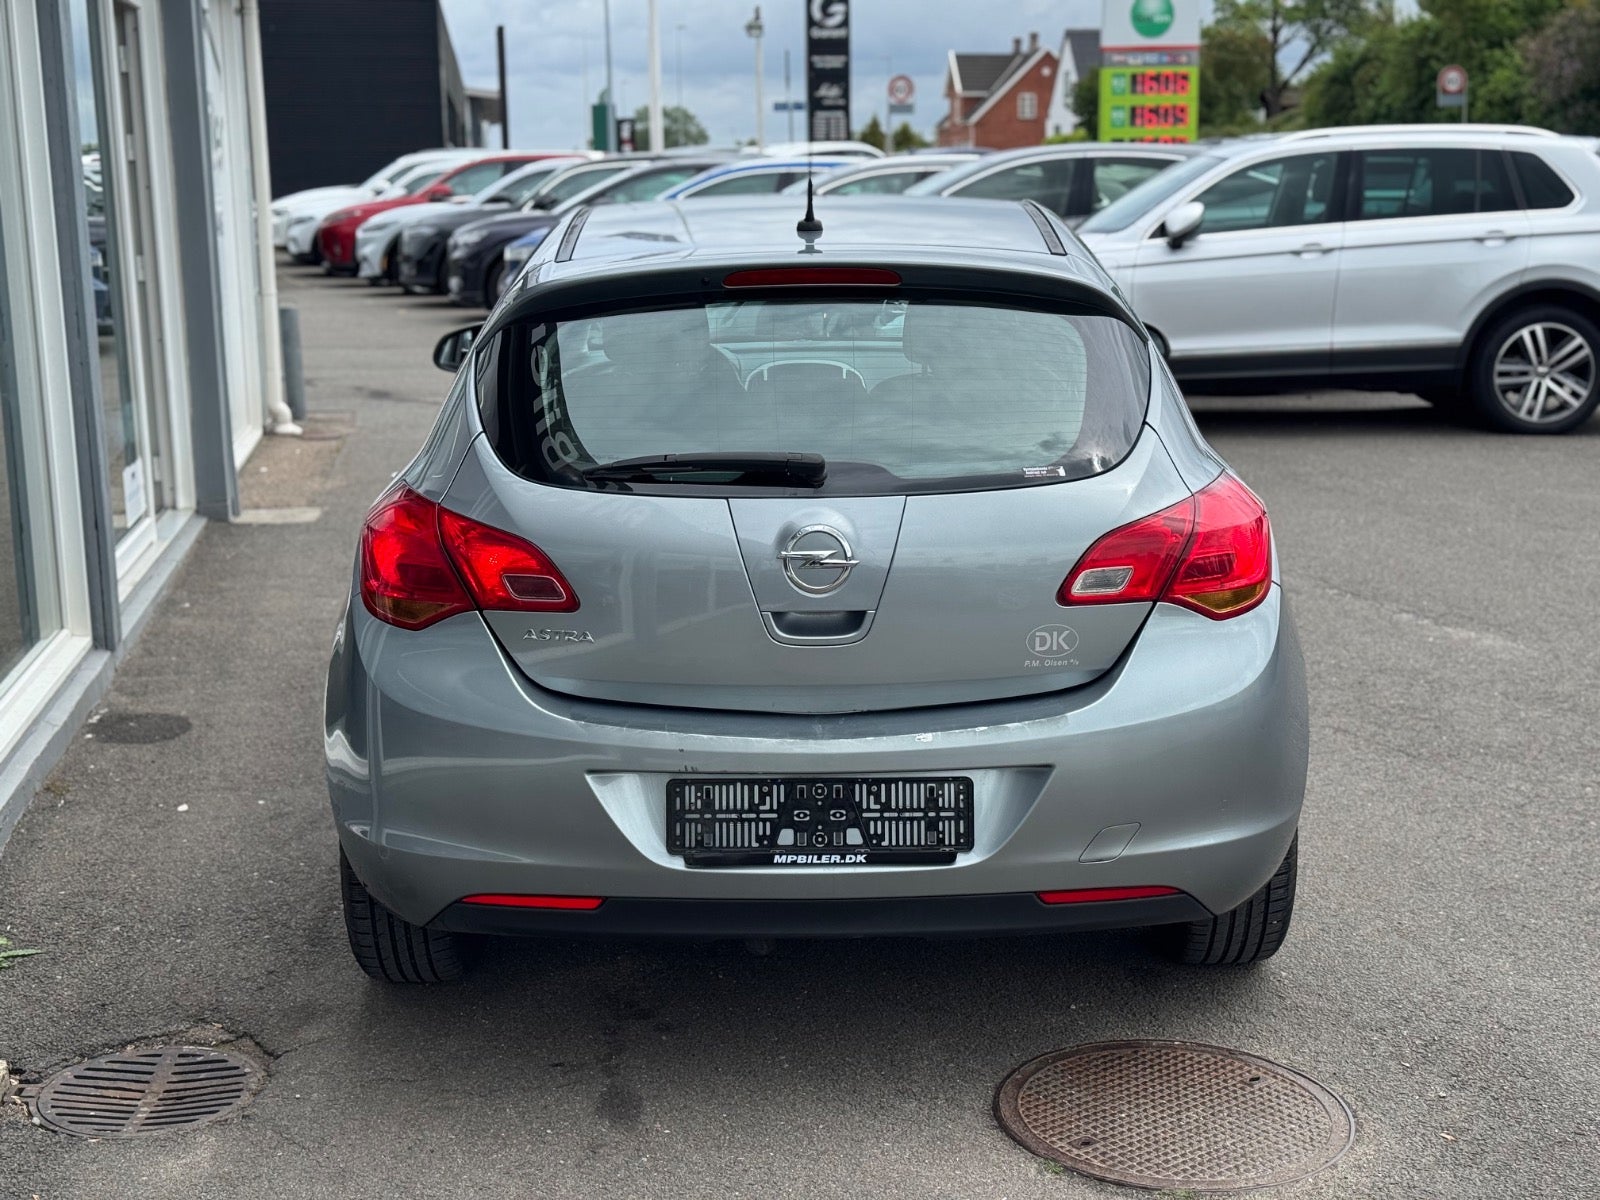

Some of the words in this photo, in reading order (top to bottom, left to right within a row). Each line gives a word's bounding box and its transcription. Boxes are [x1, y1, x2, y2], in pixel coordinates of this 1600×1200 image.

[522, 628, 595, 643] ASTRA
[1034, 630, 1071, 652] DK
[1044, 659, 1068, 667] Olsen
[773, 854, 868, 864] MPBILER.DK
